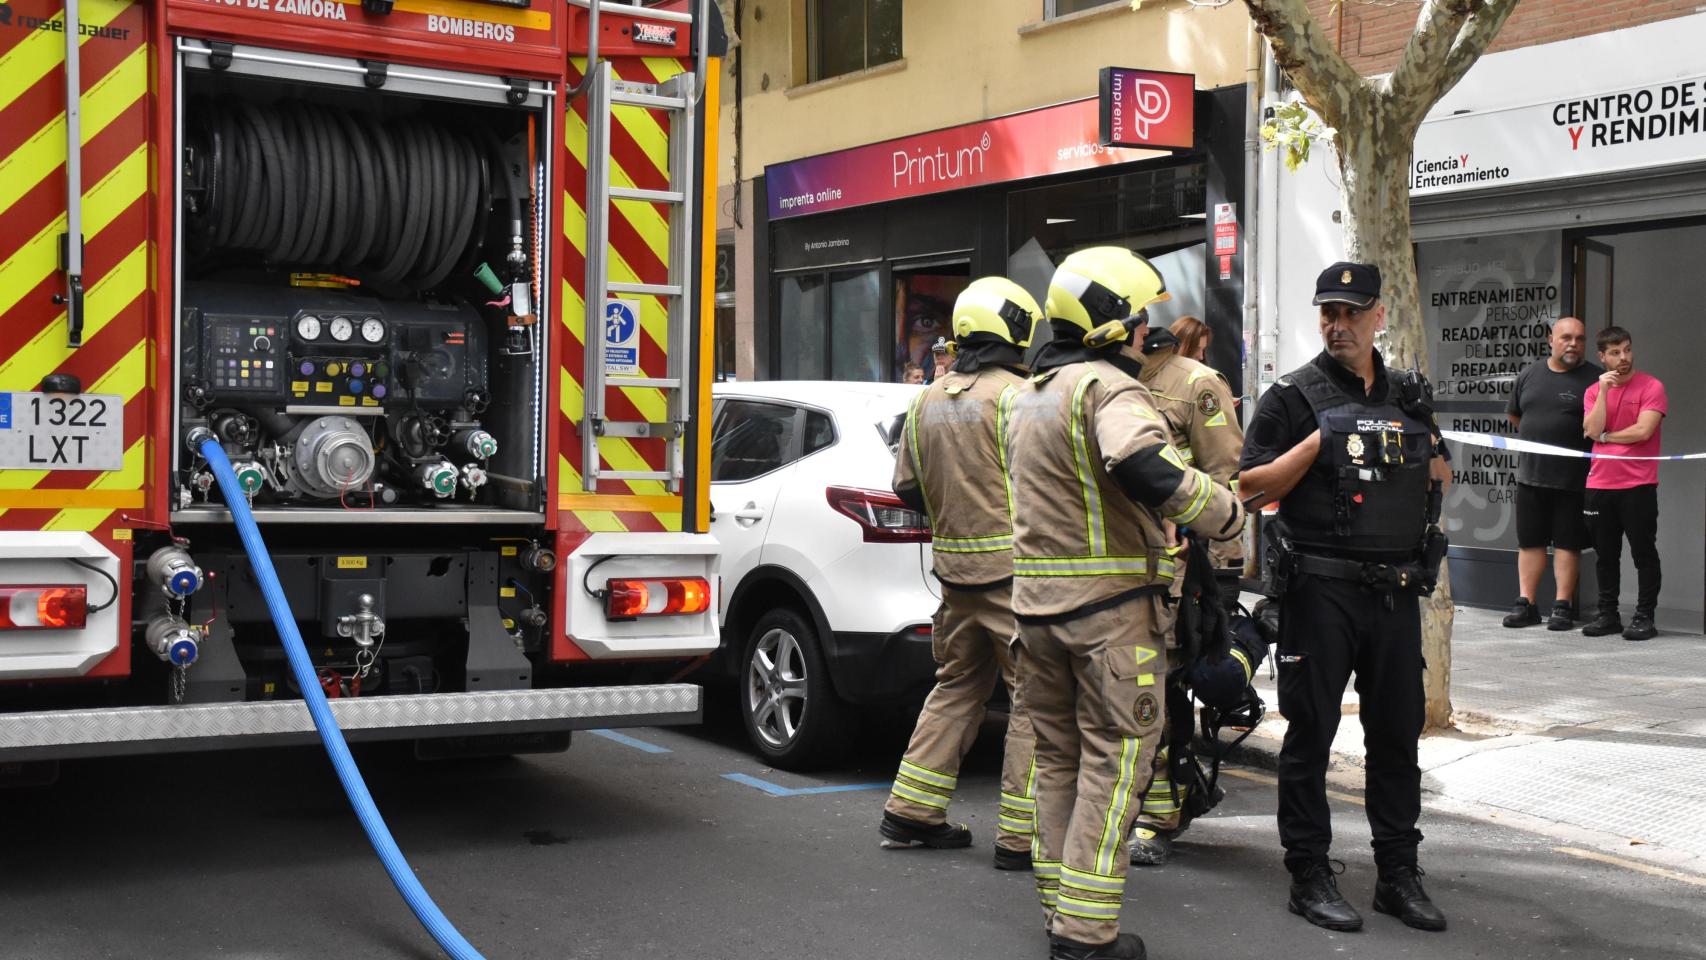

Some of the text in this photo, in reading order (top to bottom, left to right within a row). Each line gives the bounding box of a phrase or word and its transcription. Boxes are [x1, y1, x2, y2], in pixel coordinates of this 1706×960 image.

[274, 0, 347, 21] ZAMORA
[17, 15, 131, 41] rosebauer
[427, 14, 516, 43] BOMBEROS
[1113, 73, 1124, 142] imprenta
[1552, 89, 1653, 127] CENTRO
[1661, 81, 1696, 110] DE
[1567, 125, 1584, 151] Y
[892, 146, 984, 188] Printum
[1415, 165, 1510, 190] Entrenamiento
[1416, 154, 1469, 175] Ciencia Y
[779, 187, 842, 210] imprenta online
[1431, 285, 1558, 307] ENTRENAMIENTO
[1486, 304, 1557, 322] PERSONAL
[1465, 344, 1482, 359] DE
[31, 397, 107, 427] 1322
[29, 434, 90, 464] LXT
